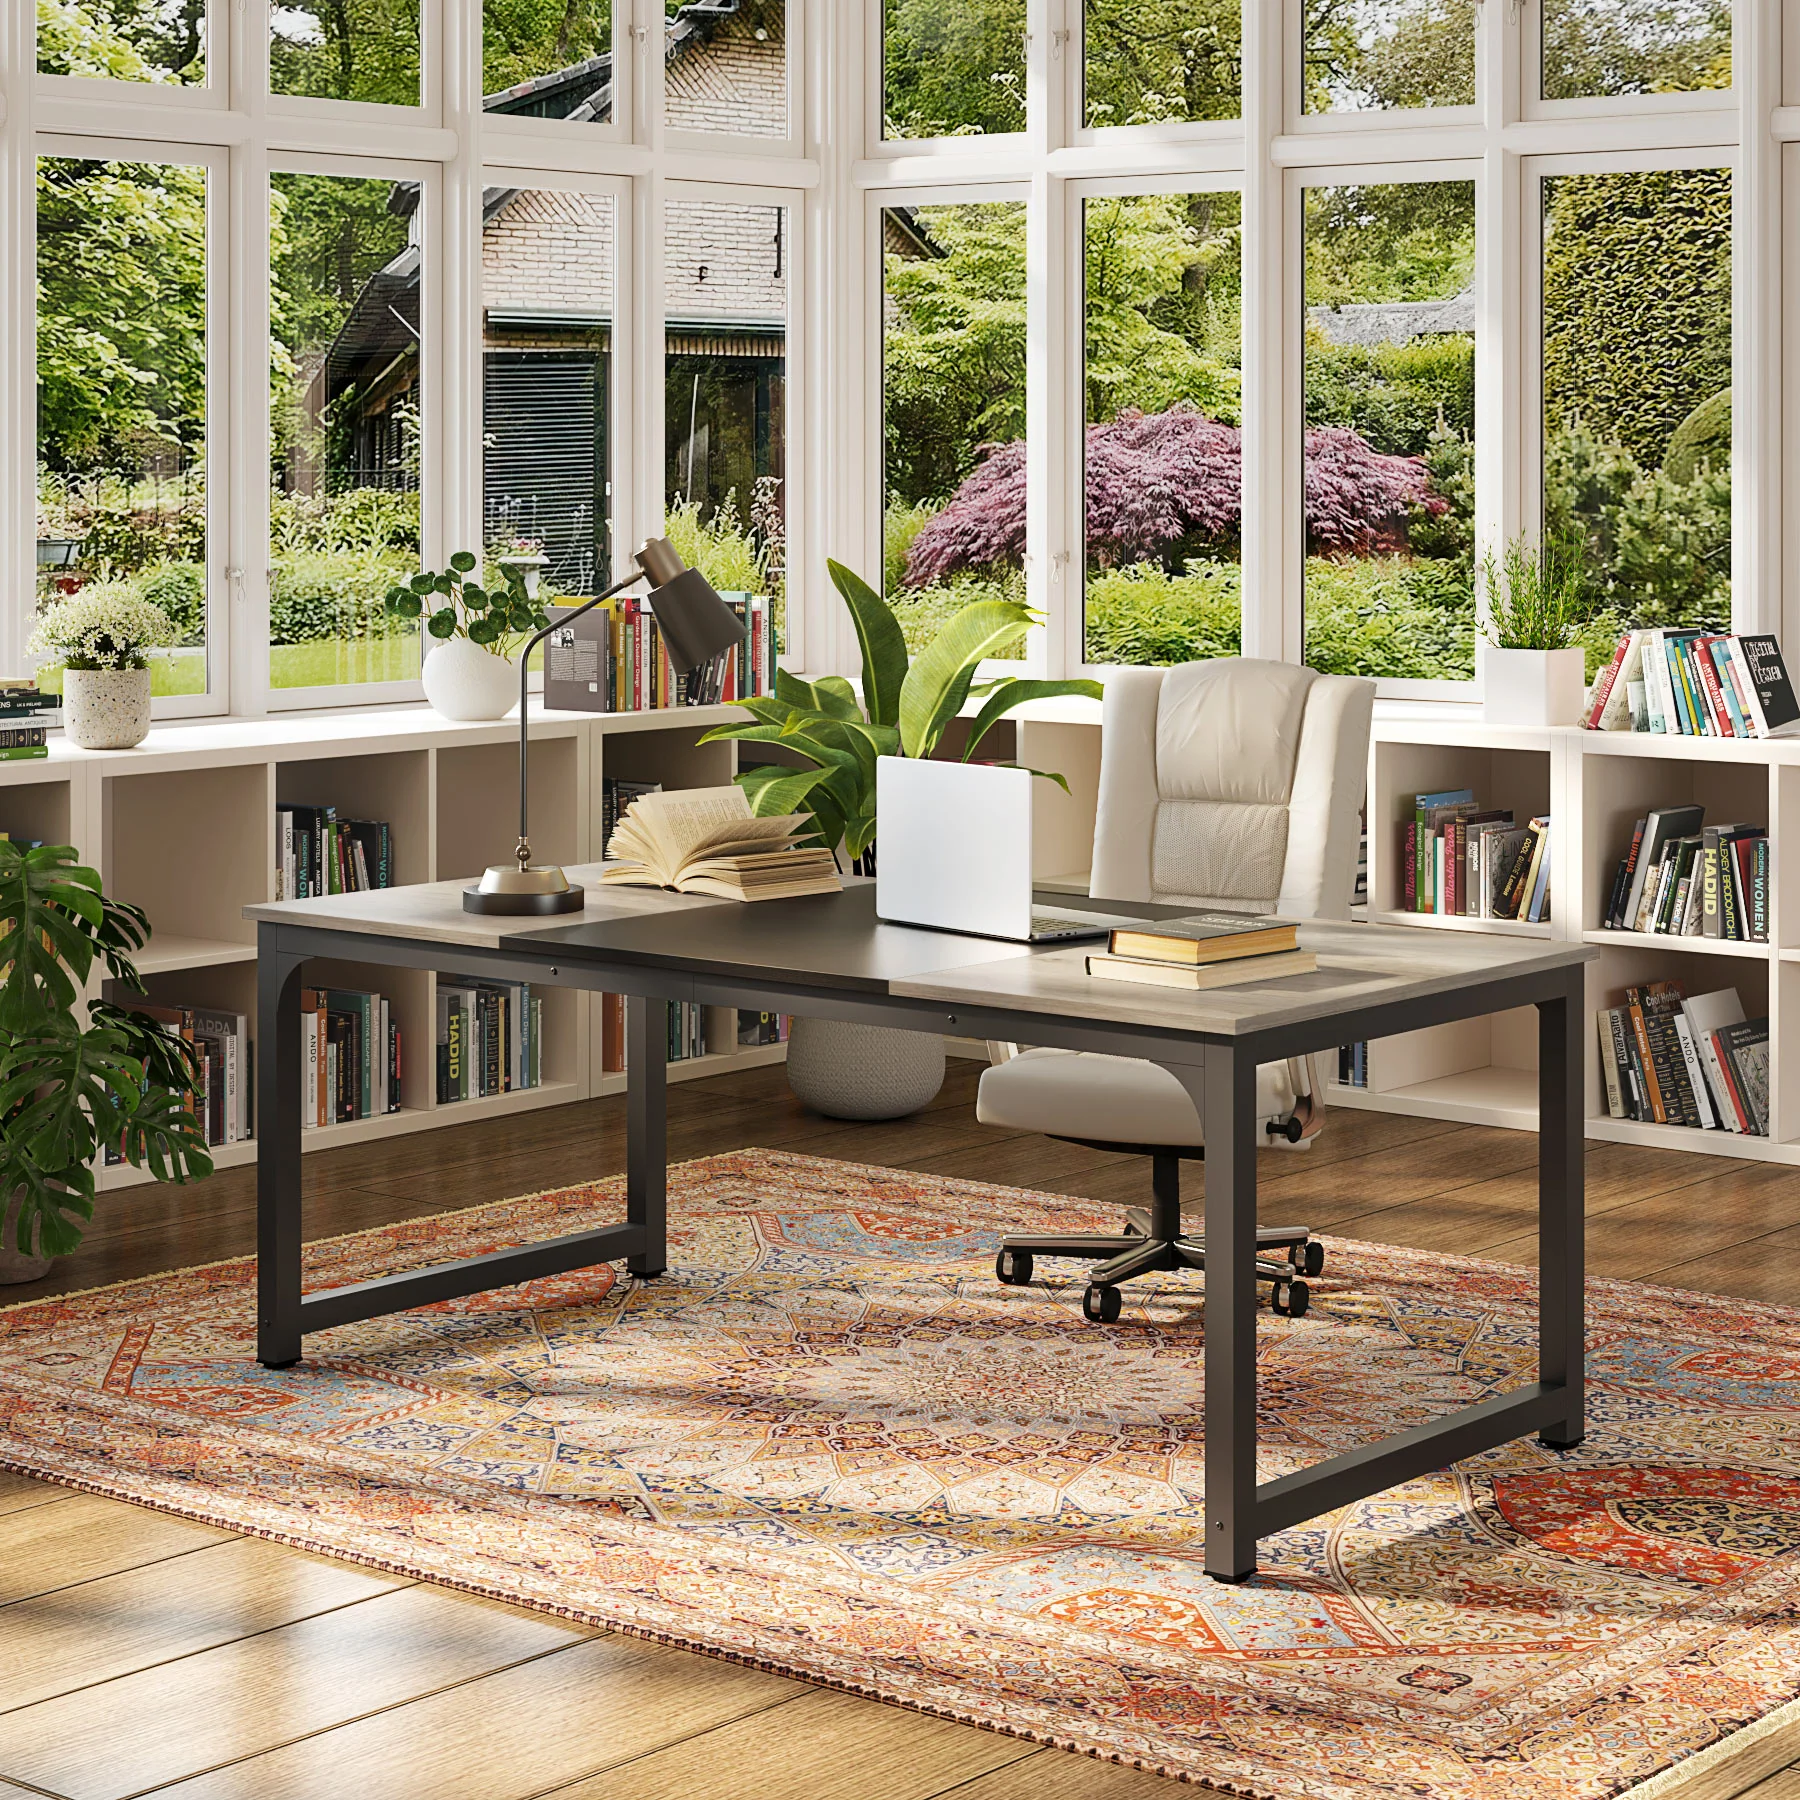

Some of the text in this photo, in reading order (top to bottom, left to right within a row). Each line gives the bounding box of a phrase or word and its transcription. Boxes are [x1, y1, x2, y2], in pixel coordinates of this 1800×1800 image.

[1704, 662, 1725, 712] ANTIQUAIRES
[1405, 823, 1416, 899] Martin Parr
[1416, 851, 1424, 871] Design
[1444, 826, 1456, 902] Martin Parr
[1502, 837, 1532, 897] COOL GUIDE London
[1719, 837, 1731, 873] ALEXEY
[1757, 842, 1765, 877] MODERN
[1704, 848, 1717, 916] HADID
[1722, 874, 1736, 934] BRODOVITCH
[1754, 877, 1765, 932] WOMEN
[1634, 1016, 1642, 1032] Cool
[1645, 994, 1660, 1007] Cool
[228, 1036, 236, 1096] DIGITAL BY DESIGN
[449, 1014, 460, 1080] HADID
[1637, 1032, 1647, 1054] Hotels
[1681, 1035, 1695, 1064] ANDO
